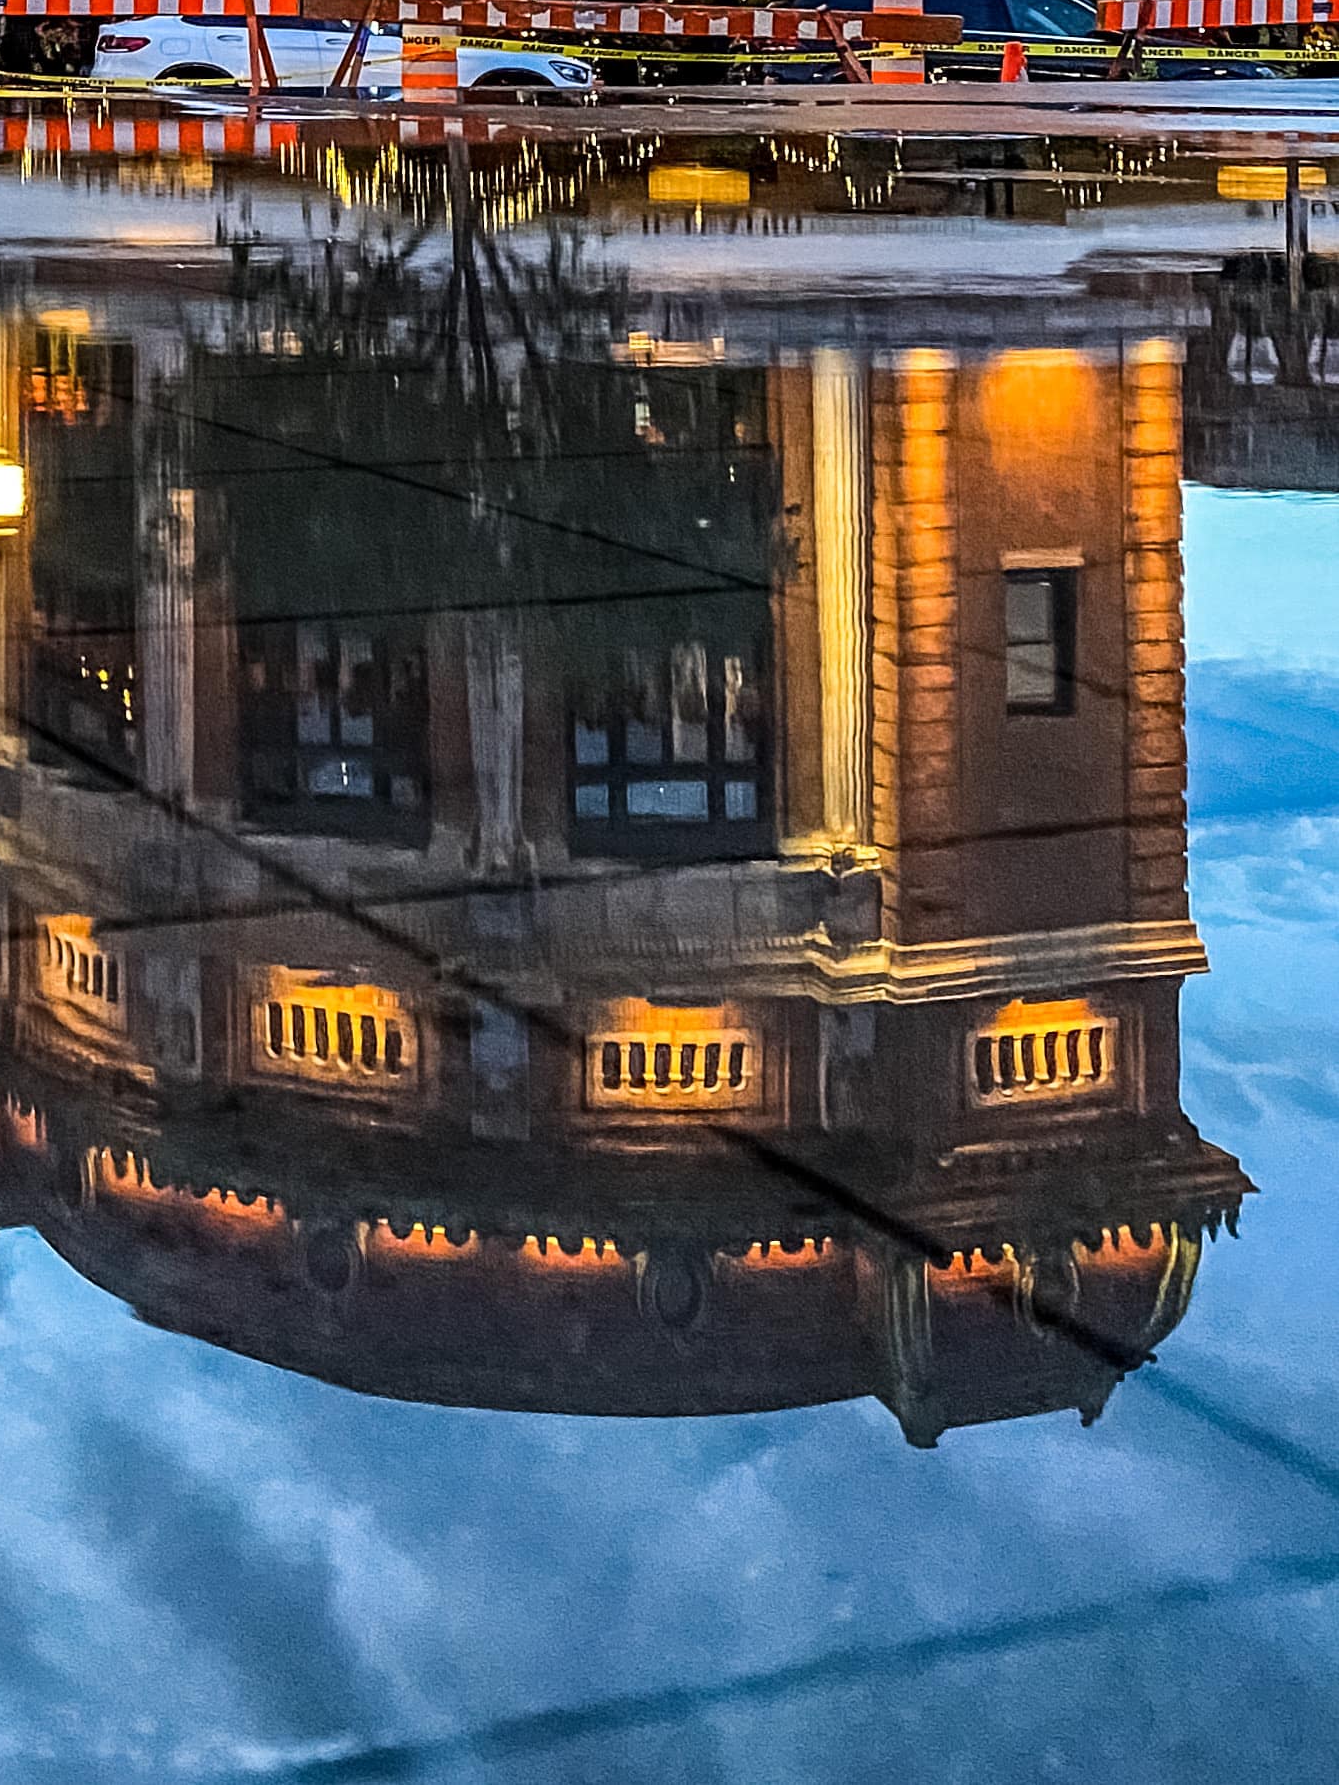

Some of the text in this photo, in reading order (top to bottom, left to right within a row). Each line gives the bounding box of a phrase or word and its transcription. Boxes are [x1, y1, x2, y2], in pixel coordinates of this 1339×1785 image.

[460, 38, 504, 50] DANGER
[978, 44, 1030, 53] DANR
[1054, 46, 1107, 55] DANGER
[1207, 50, 1260, 58] DANGER
[1284, 51, 1338, 60] DANGER
